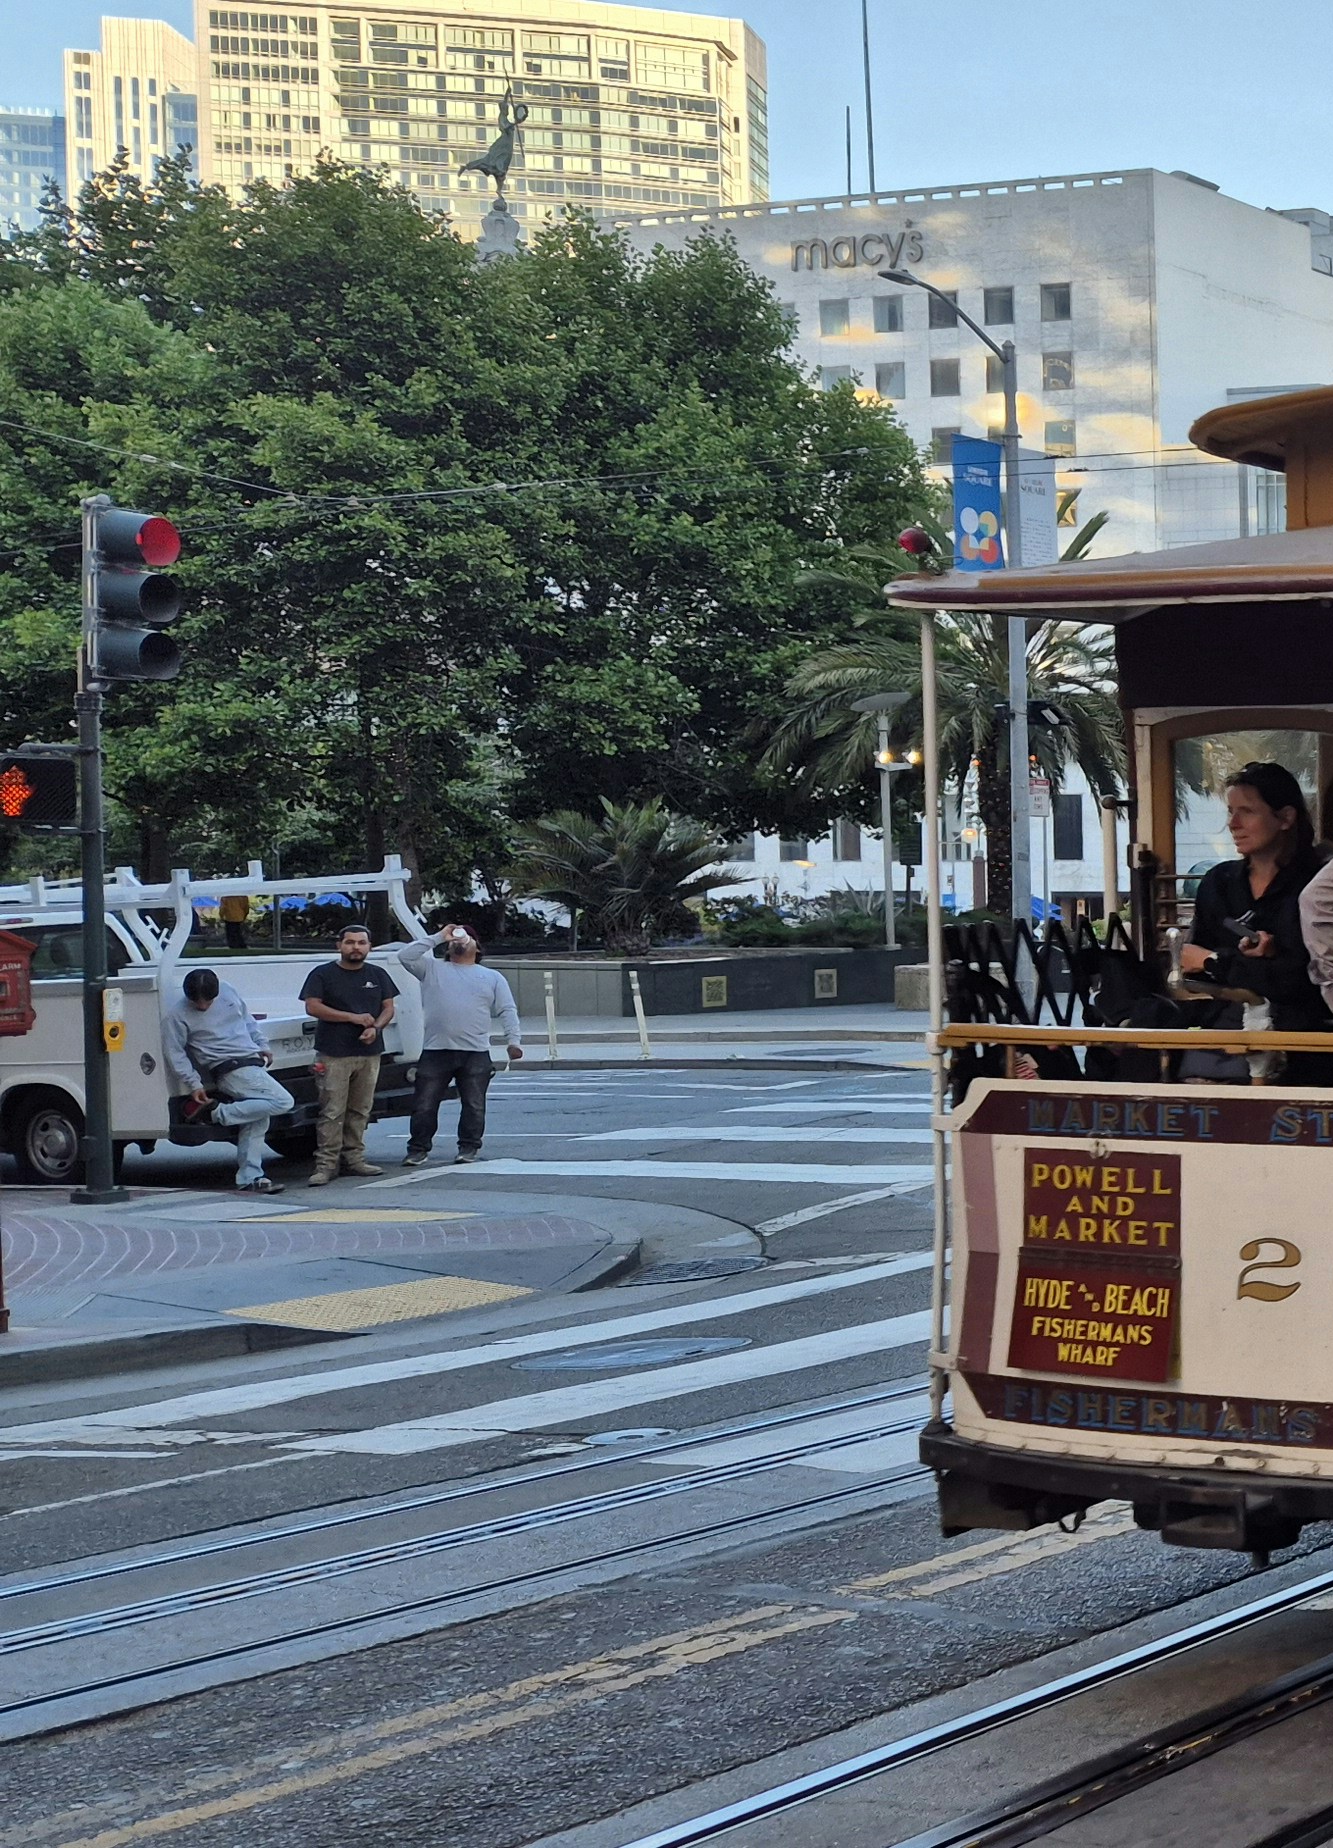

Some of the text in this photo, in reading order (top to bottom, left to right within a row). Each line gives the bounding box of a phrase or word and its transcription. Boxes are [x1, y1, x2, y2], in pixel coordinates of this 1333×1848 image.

[790, 219, 923, 272] macy's
[1028, 1100, 1220, 1138] MARKET
[1031, 1163, 1173, 1195] POWELL
[1065, 1195, 1136, 1217] AND
[1027, 1214, 1175, 1247] MARKET
[1237, 1237, 1302, 1302] 2
[1023, 1277, 1075, 1312] HYDE
[1103, 1283, 1171, 1319] BEACH
[1031, 1316, 1154, 1346] FISHERMANS
[1057, 1342, 1121, 1367] WHARF
